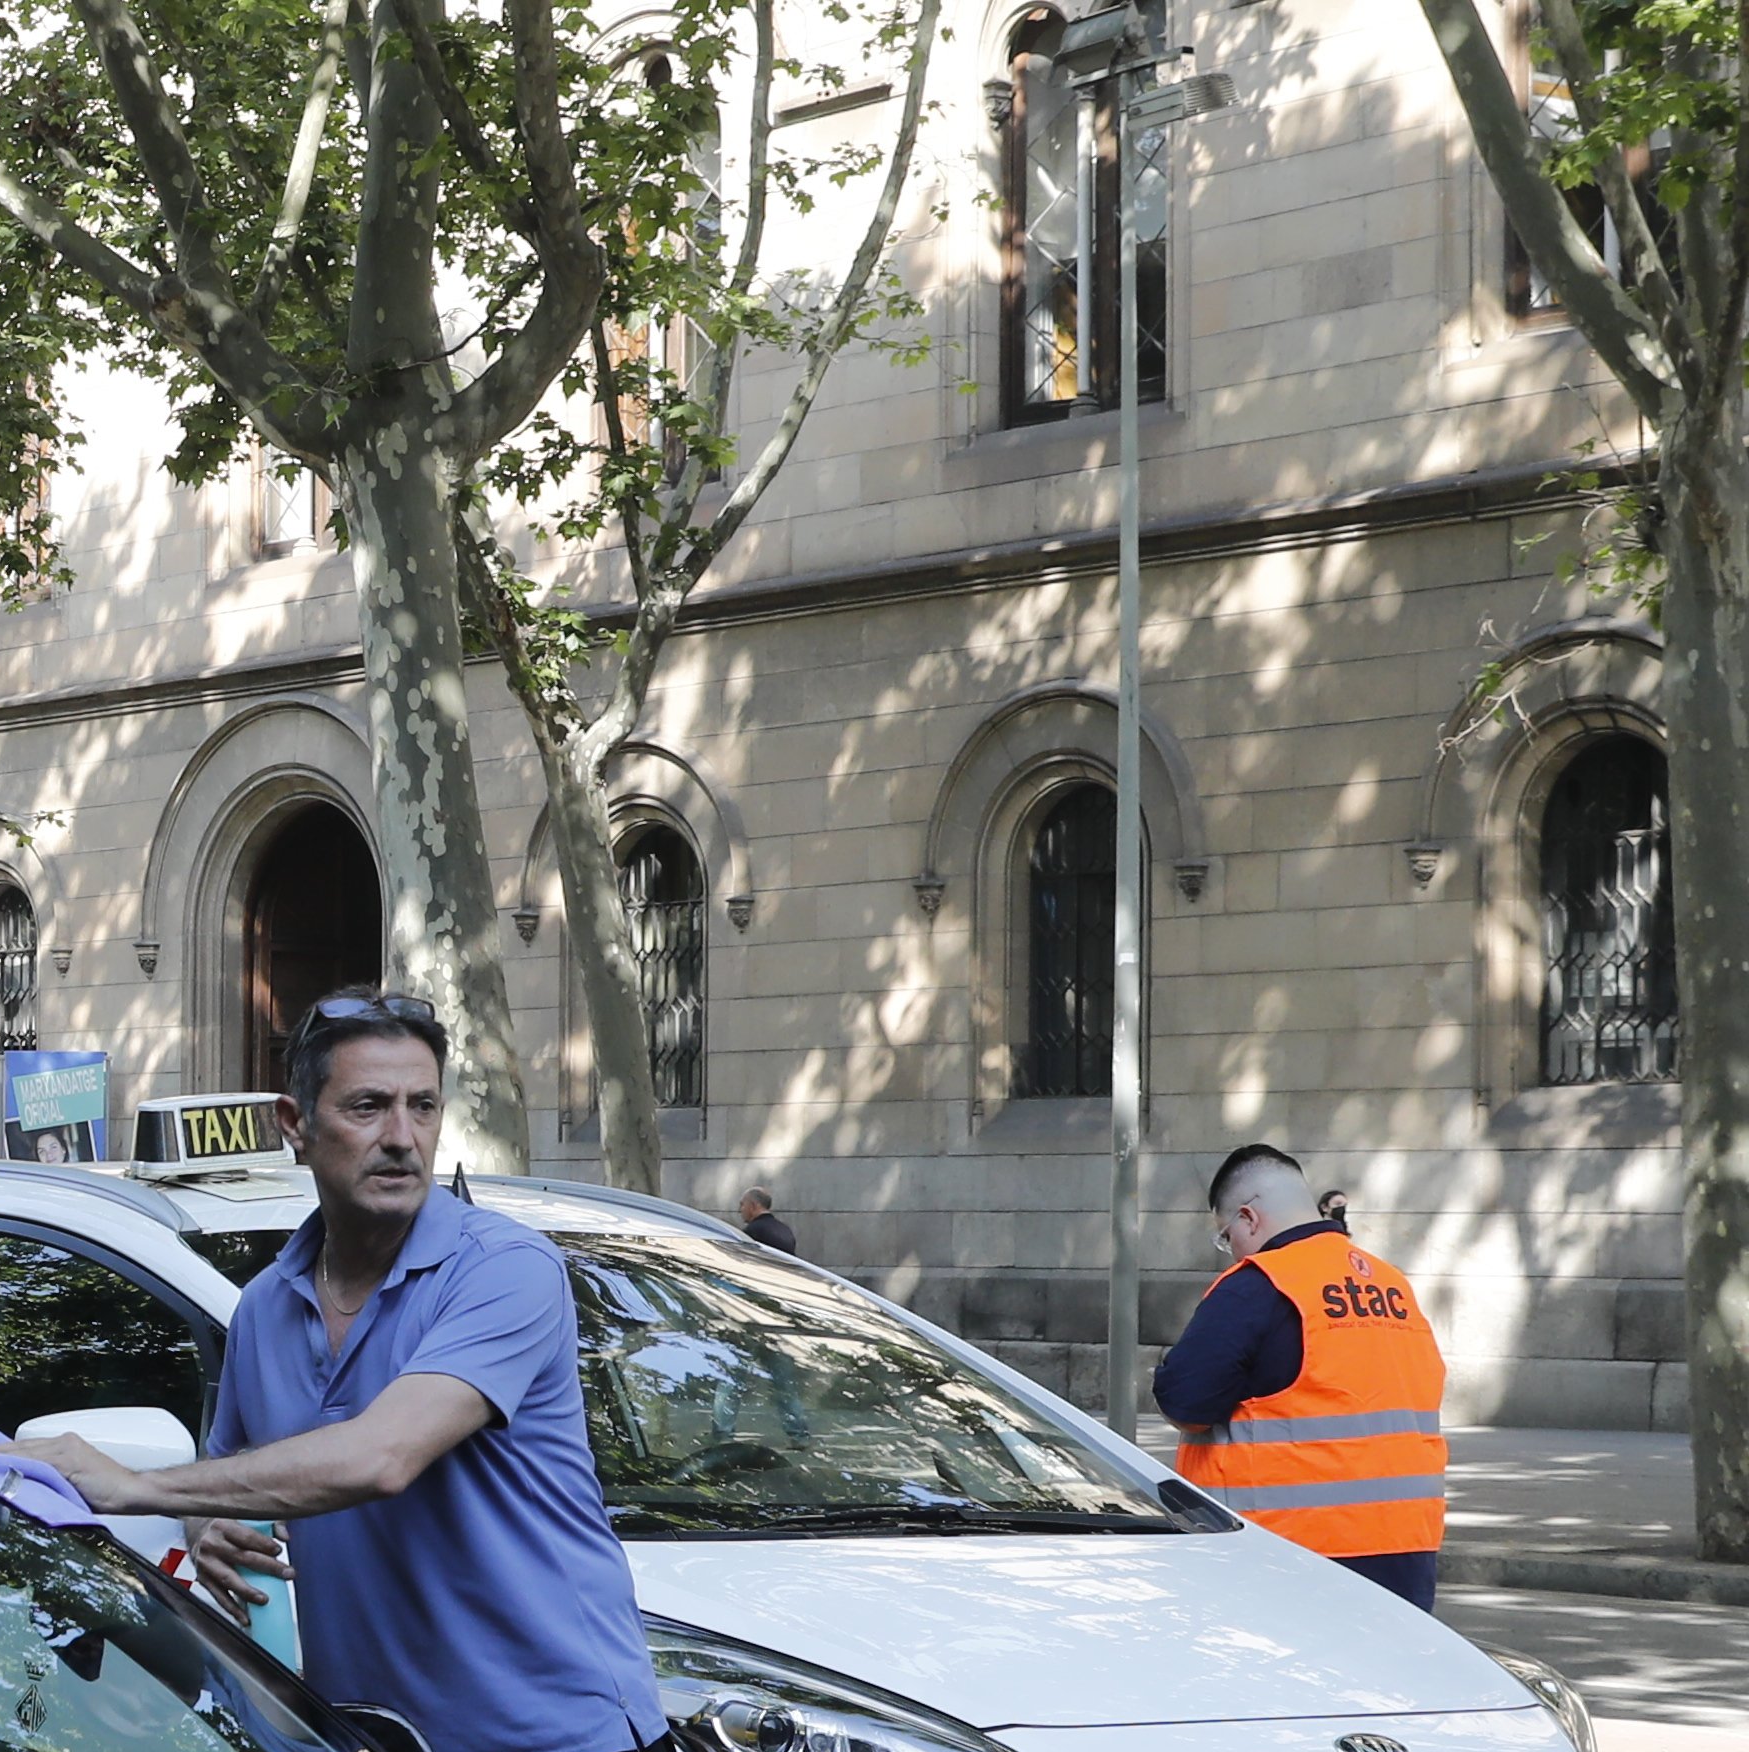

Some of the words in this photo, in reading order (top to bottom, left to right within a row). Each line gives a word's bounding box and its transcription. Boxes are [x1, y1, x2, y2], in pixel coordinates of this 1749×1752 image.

[19, 1068, 98, 1100] MARXANDATGE
[23, 1101, 64, 1126] OFICIAL
[183, 1106, 257, 1155] TAXI
[1322, 1276, 1407, 1320] stac
